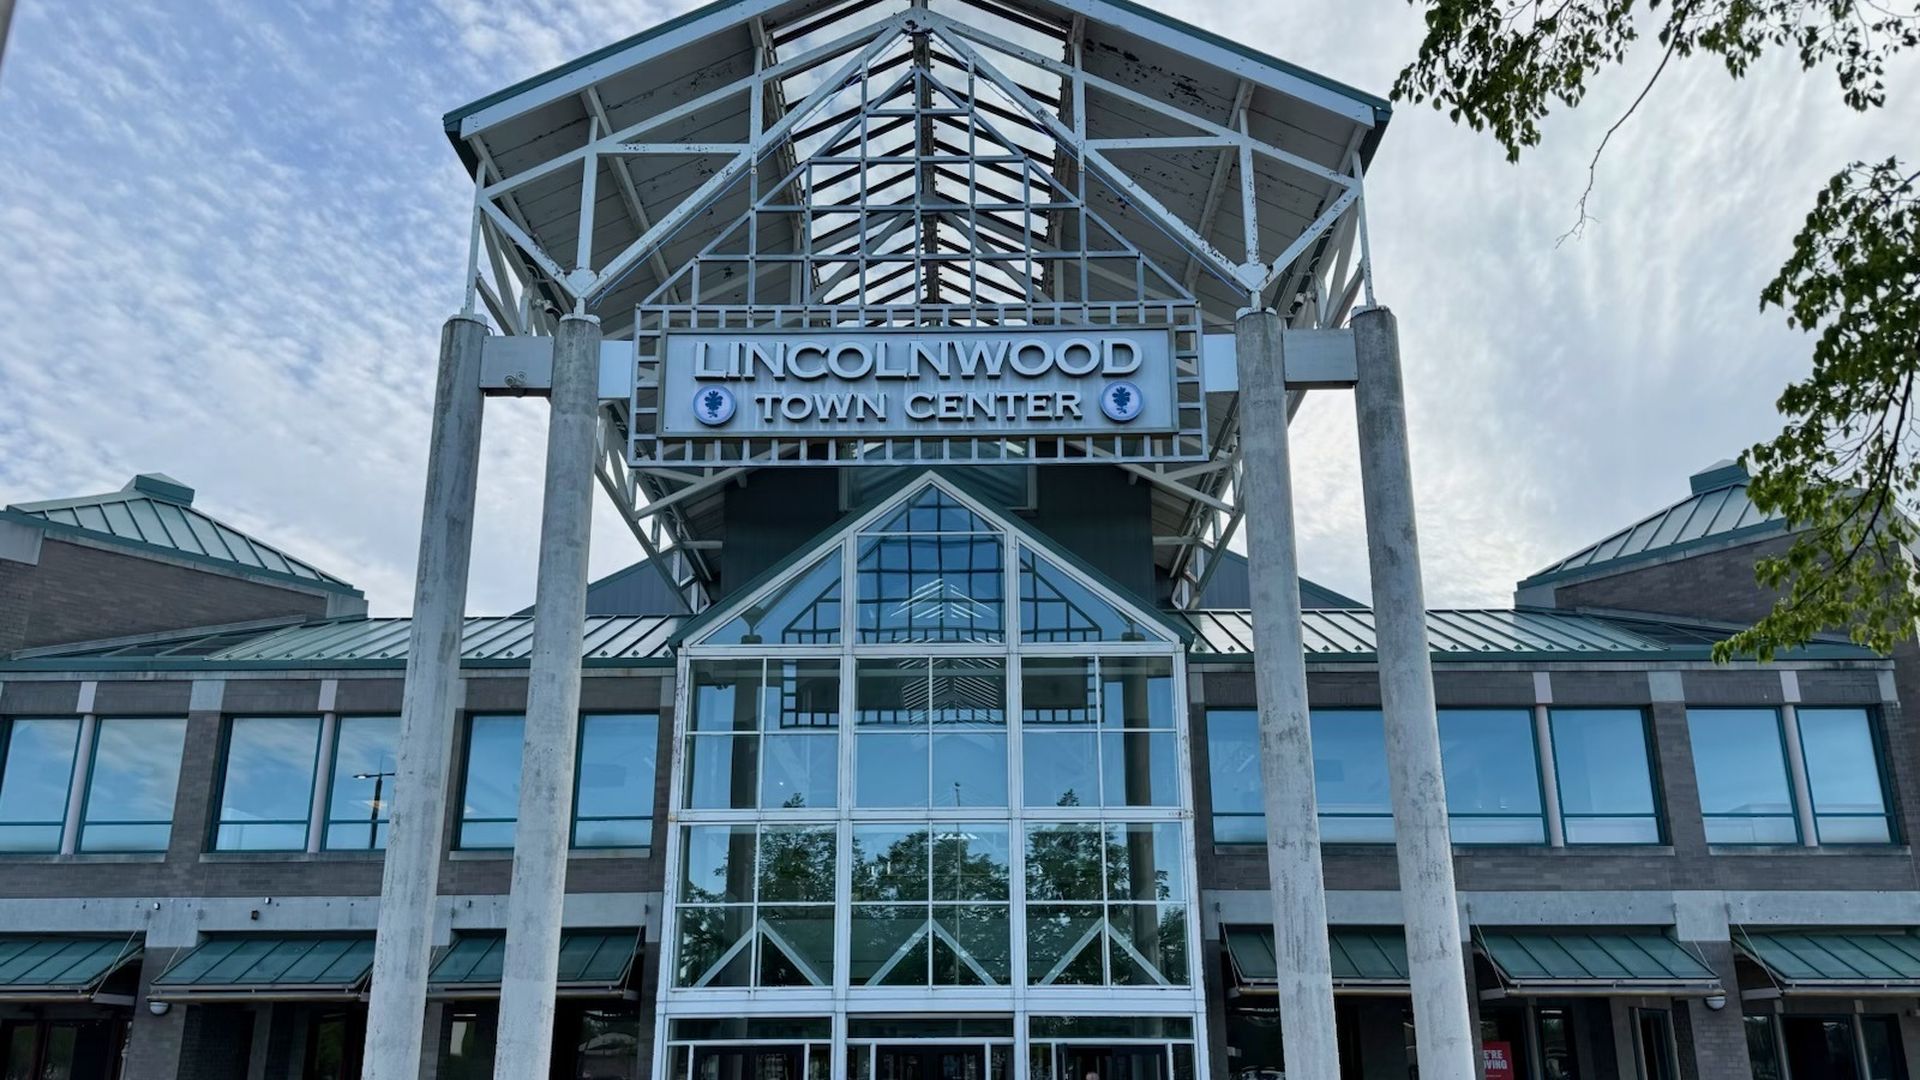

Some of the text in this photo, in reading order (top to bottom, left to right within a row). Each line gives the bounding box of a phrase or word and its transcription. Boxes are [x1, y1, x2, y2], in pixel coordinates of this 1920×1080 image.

[694, 338, 1143, 380] LINCOLNWOOD
[754, 390, 1083, 422] TOWN CENTER
[1483, 1049, 1503, 1059] E'RE
